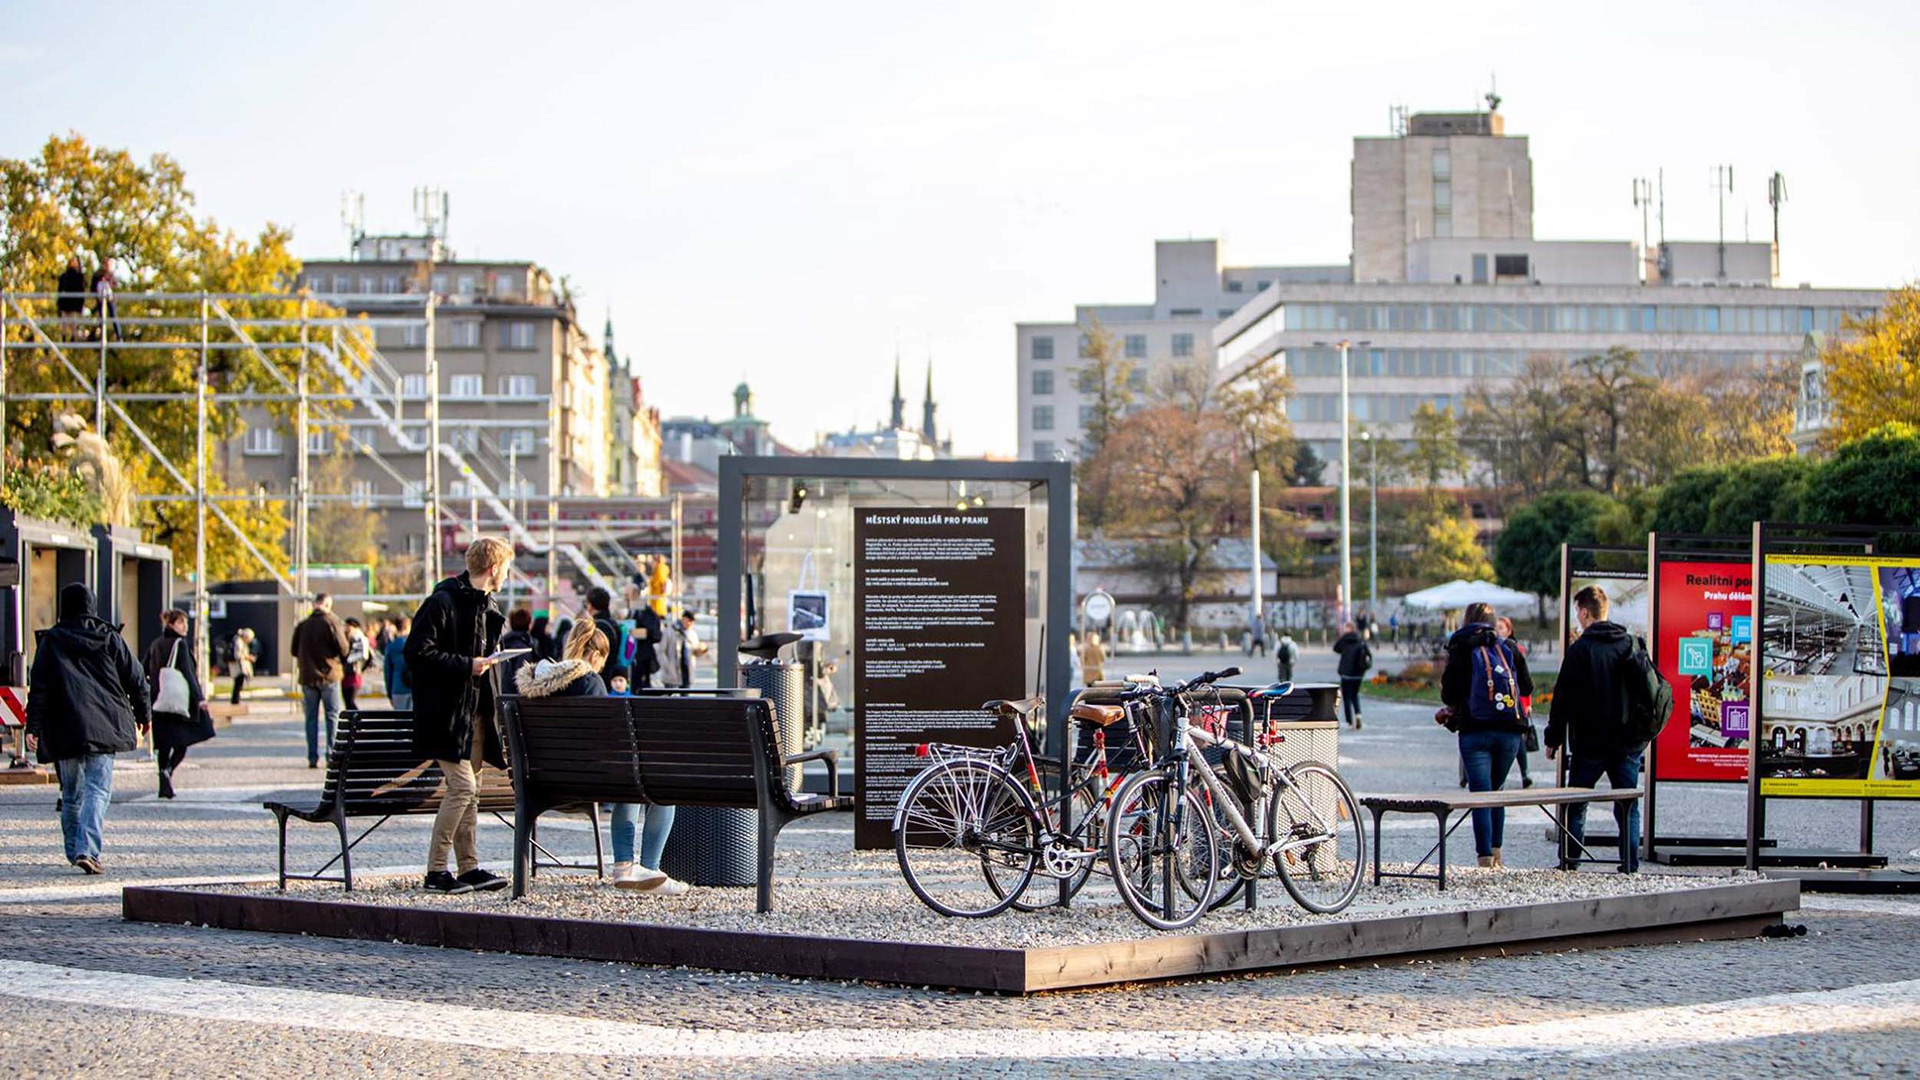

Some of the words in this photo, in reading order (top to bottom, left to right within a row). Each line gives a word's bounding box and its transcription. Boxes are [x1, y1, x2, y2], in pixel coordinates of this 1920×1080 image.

[865, 514, 901, 525] MĚSTSKÝ
[902, 514, 943, 525] MOBILIÁŘ
[944, 516, 960, 525] PRO
[962, 516, 989, 525] PRAHU
[1704, 591, 1728, 600] Prahu
